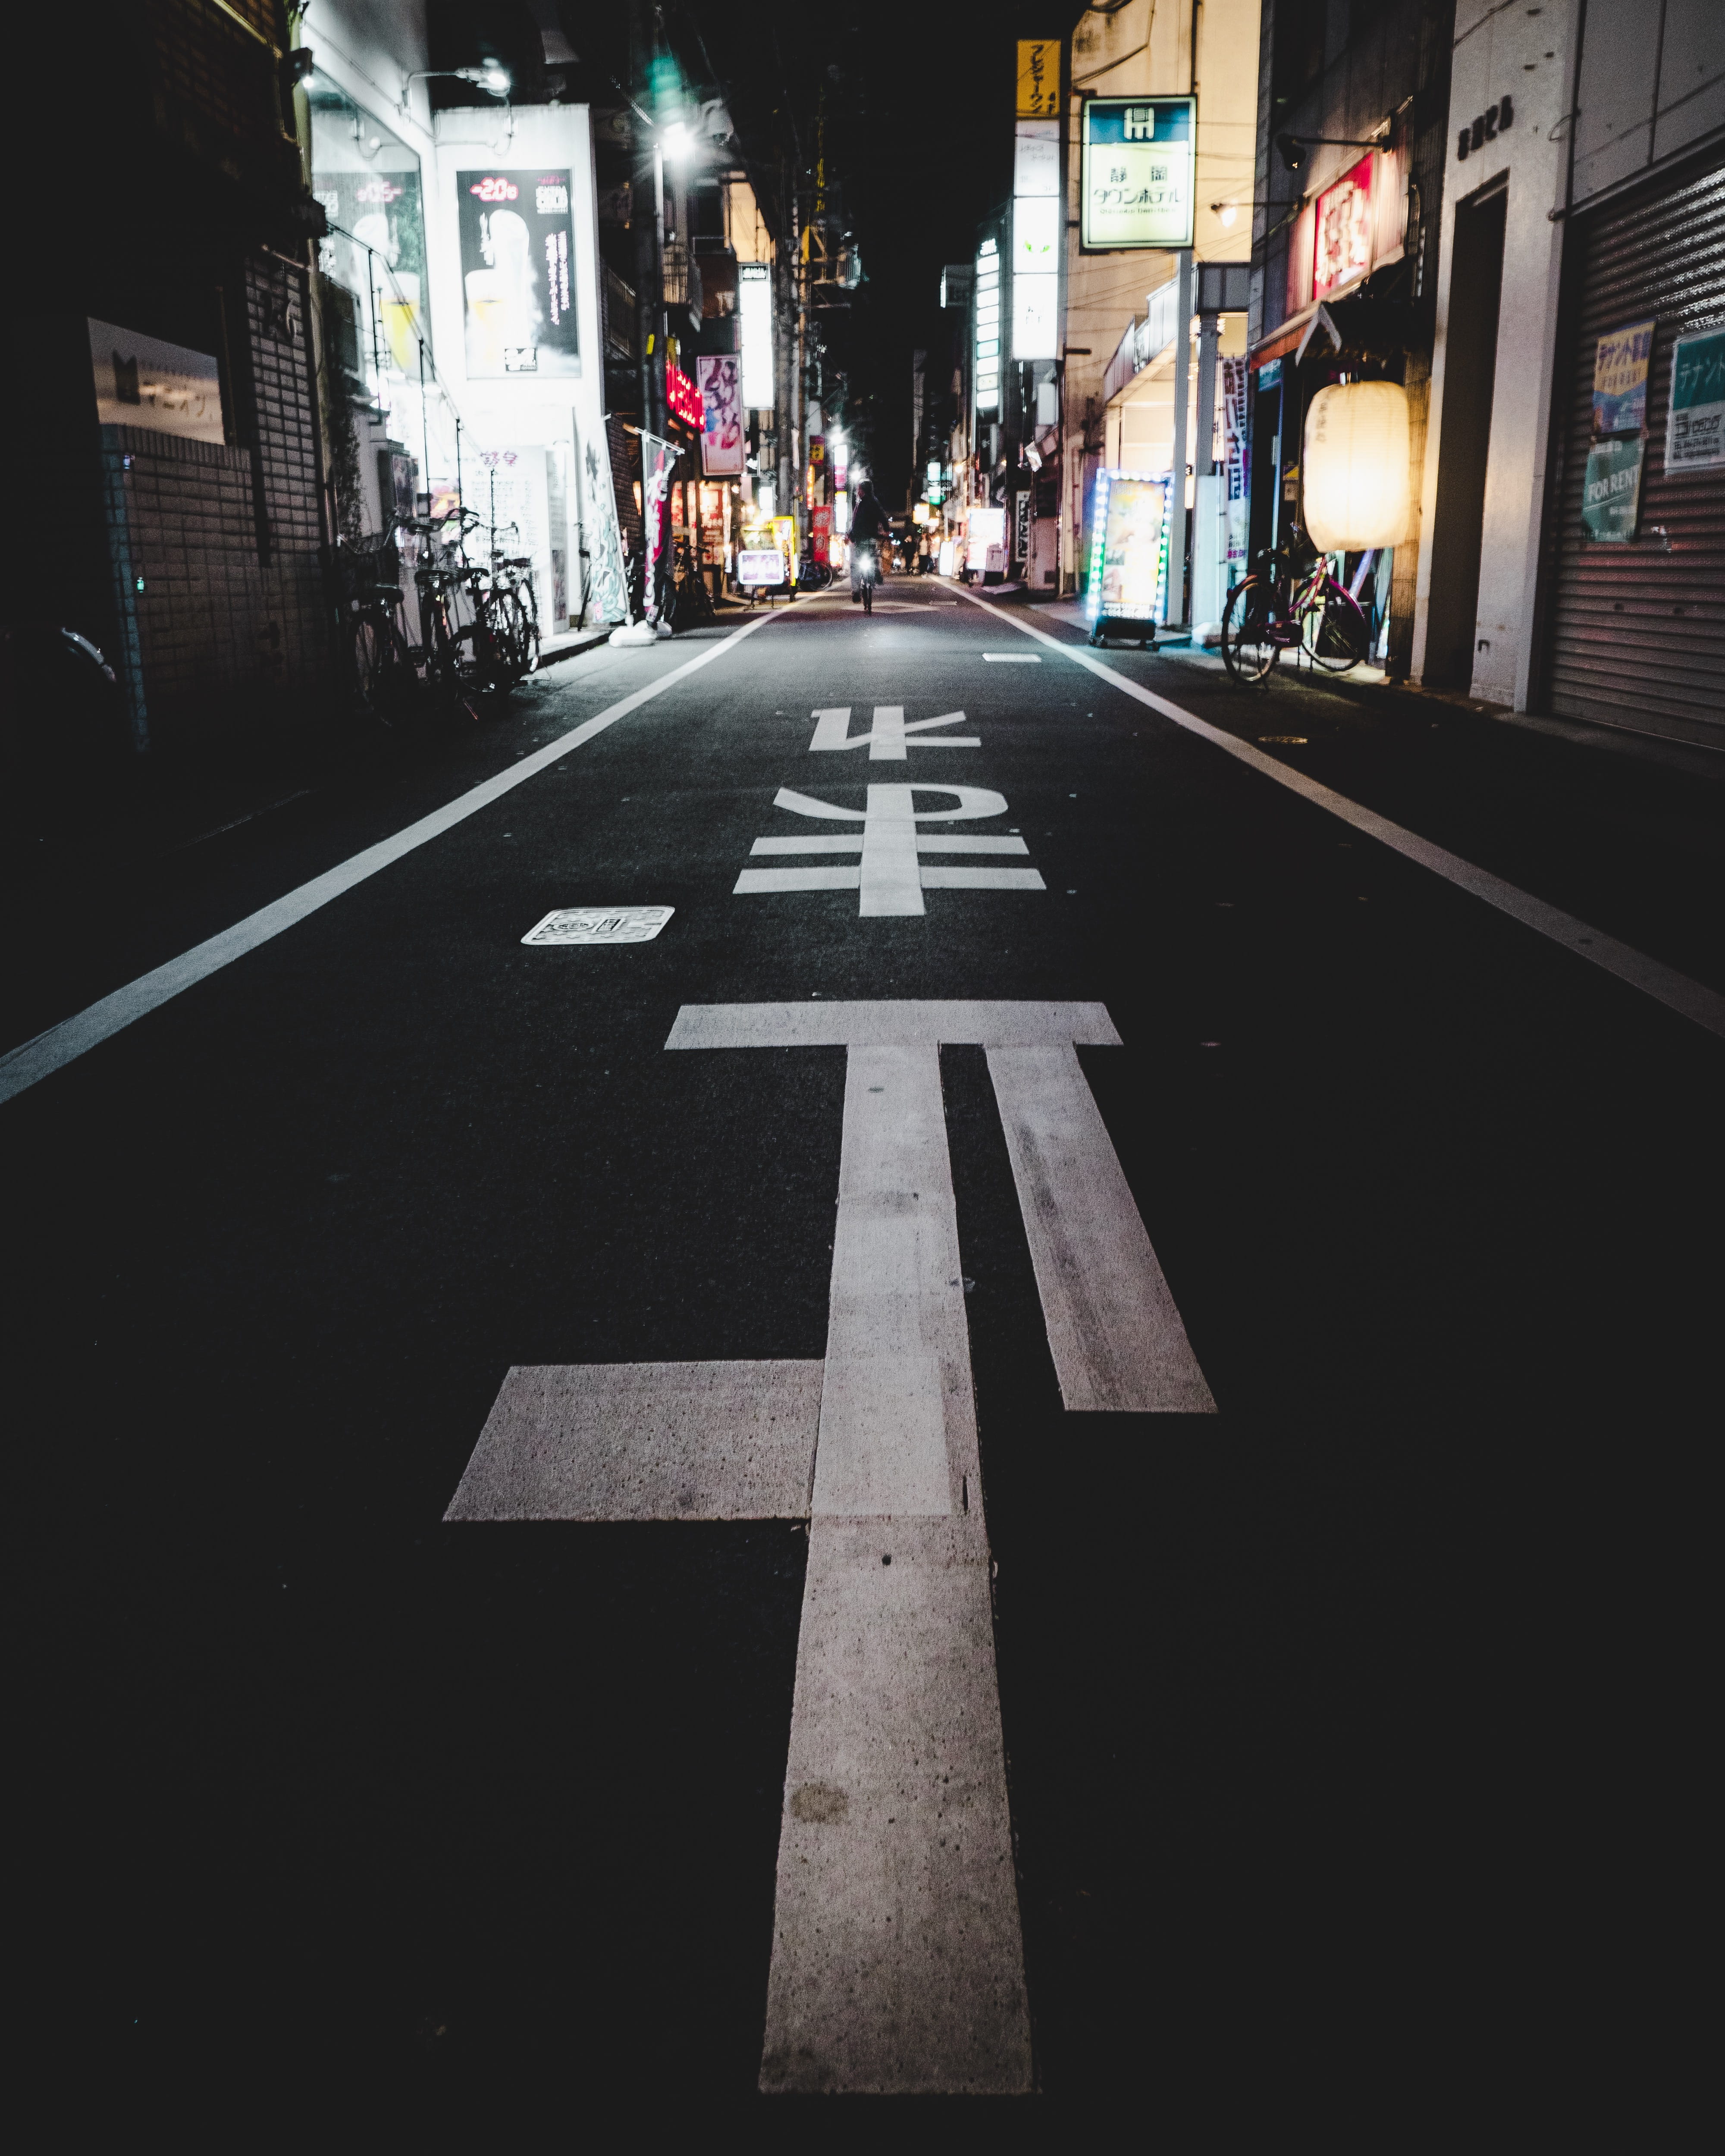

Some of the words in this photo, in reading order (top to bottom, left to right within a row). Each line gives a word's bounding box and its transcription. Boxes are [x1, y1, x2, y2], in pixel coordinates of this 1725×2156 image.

[1094, 186, 1184, 204] タウンホテル
[1588, 477, 1609, 503] FOR
[1610, 464, 1640, 493] RENT
